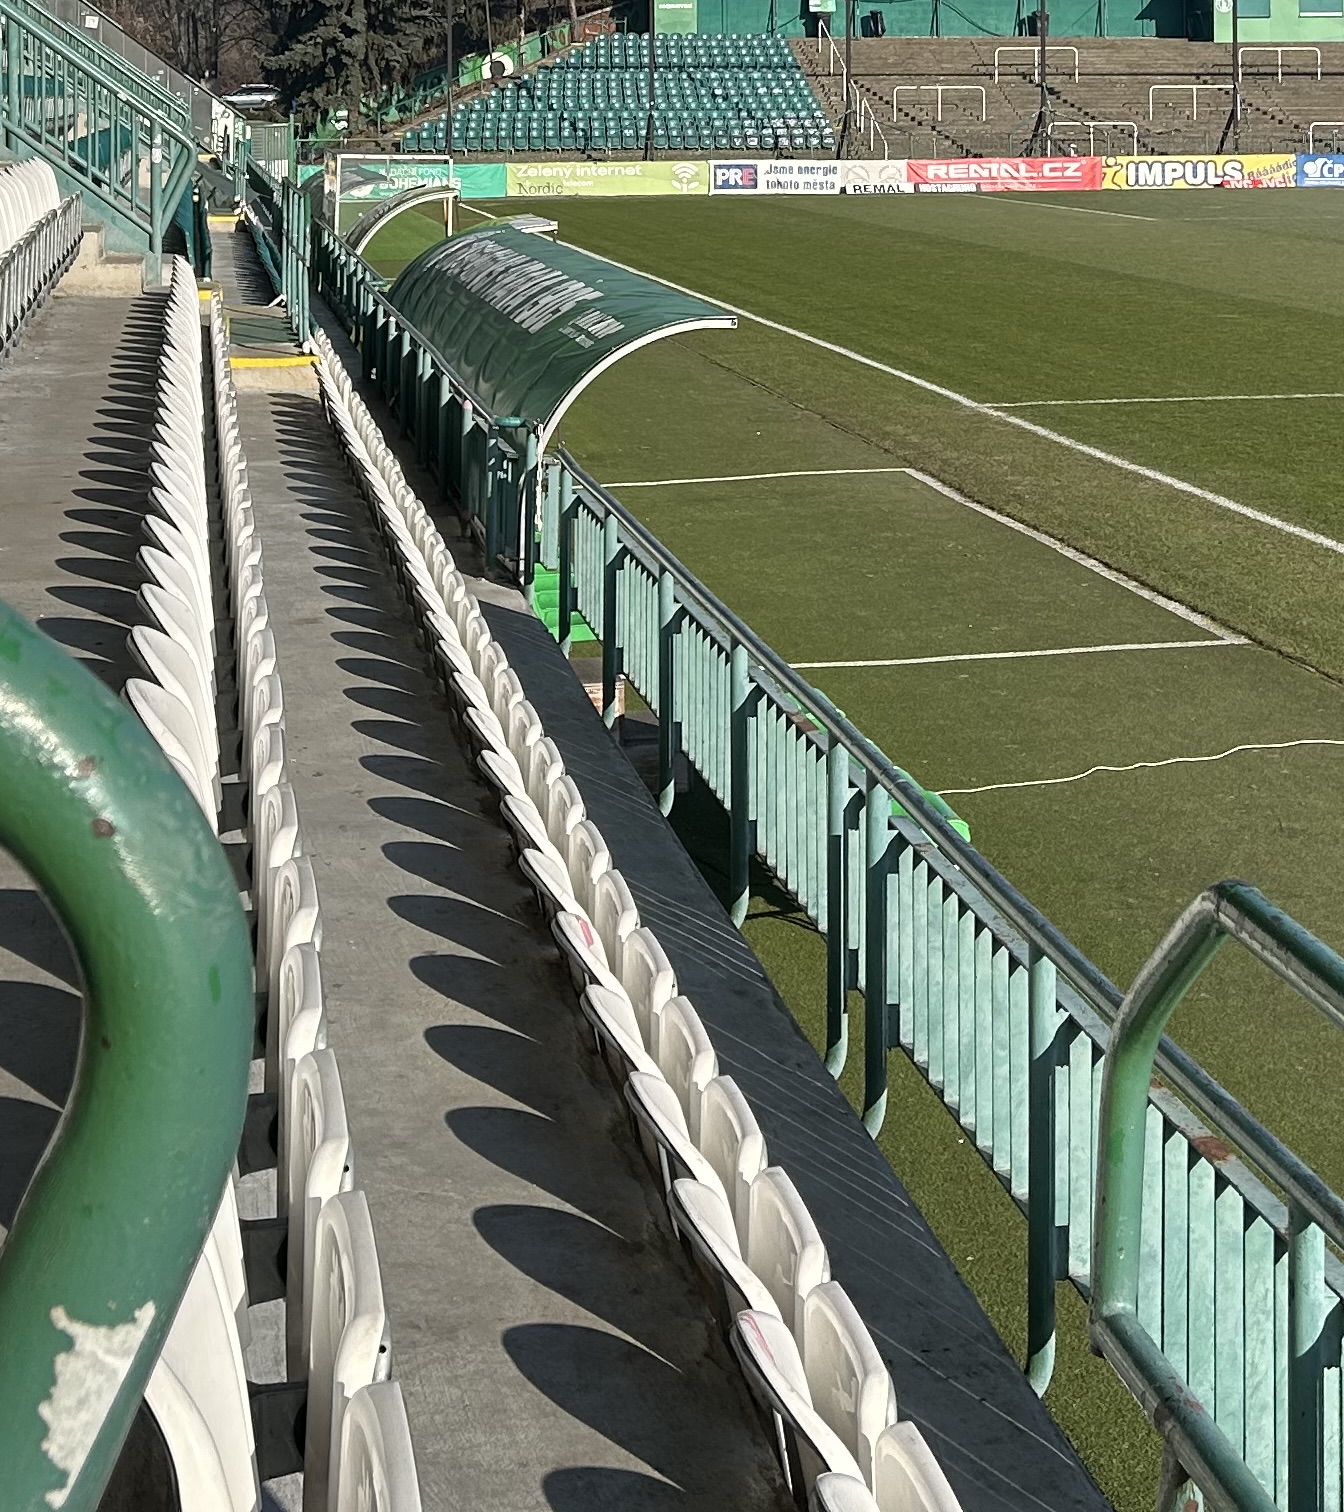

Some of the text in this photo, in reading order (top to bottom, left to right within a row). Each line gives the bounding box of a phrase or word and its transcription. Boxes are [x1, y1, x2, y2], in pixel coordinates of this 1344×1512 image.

[516, 164, 643, 179] Zelený internet
[715, 167, 756, 186] PRE
[764, 164, 794, 175] Jsme
[927, 161, 1083, 179] RENTAL.CZ
[1126, 159, 1245, 187] IMPULS
[515, 182, 564, 195] Nordic
[803, 178, 836, 190] města
[853, 184, 905, 194] REMAL
